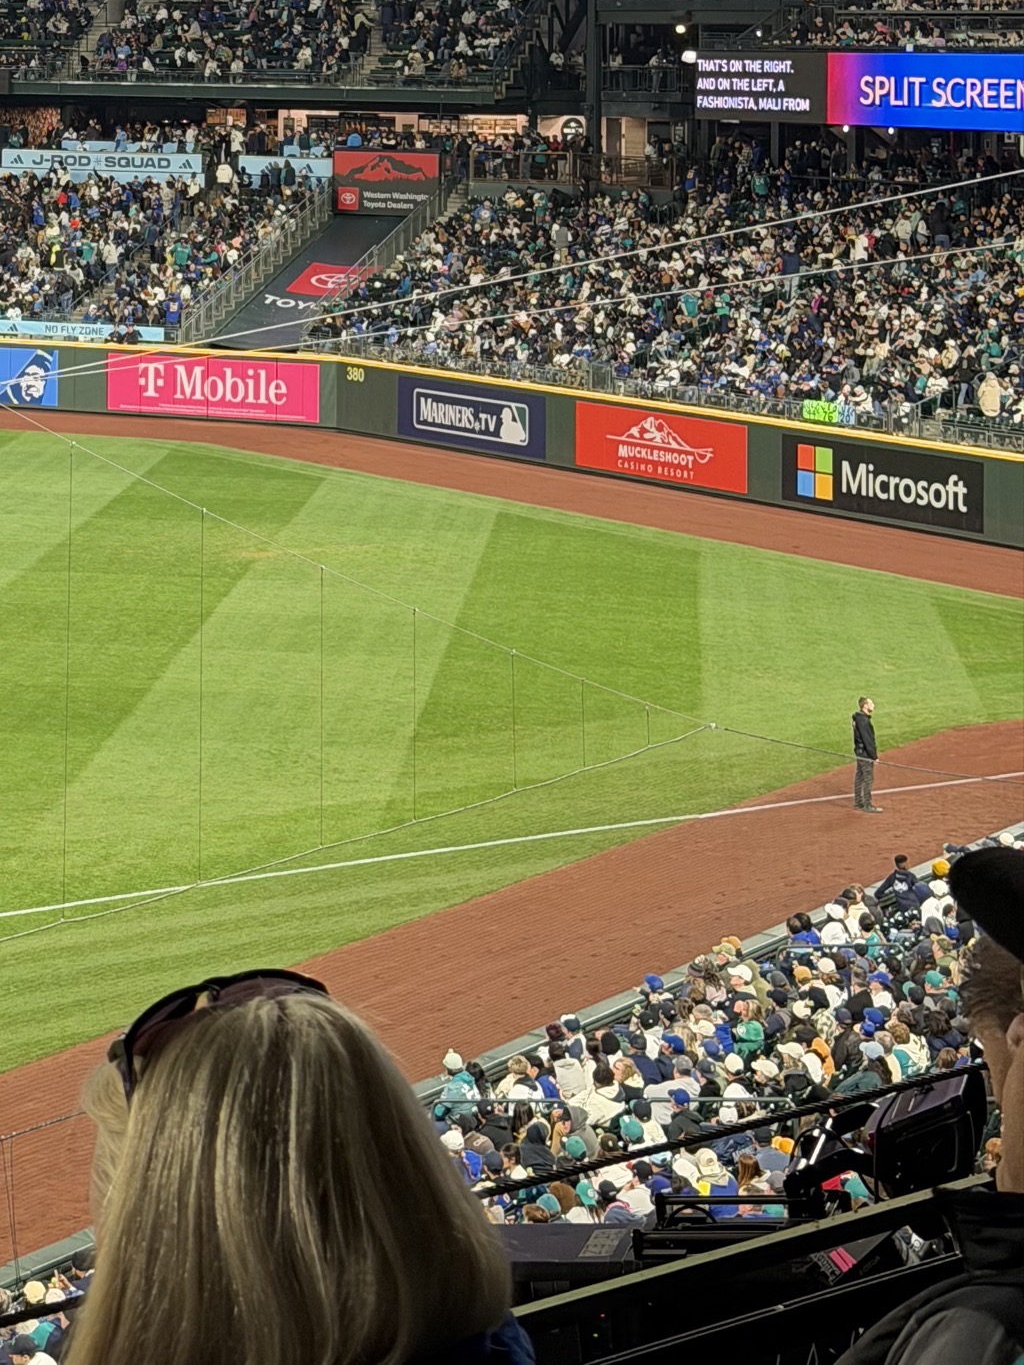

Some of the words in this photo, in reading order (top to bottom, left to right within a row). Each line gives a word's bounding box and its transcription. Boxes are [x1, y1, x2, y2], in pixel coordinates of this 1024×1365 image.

[697, 59, 728, 72] THAT'S
[729, 60, 742, 72] ON
[744, 60, 762, 73] THE
[763, 60, 794, 74] RIGHT.
[696, 78, 716, 90] AND
[717, 78, 730, 90] ON
[731, 78, 750, 91] THE
[751, 78, 776, 93] LEFT,
[777, 79, 785, 92] A
[859, 75, 926, 106] SPLIT
[696, 96, 757, 111] FASHIONISTA,
[758, 98, 781, 111] MALI
[782, 98, 810, 112] FROM
[31, 154, 91, 167] J-ROD
[104, 156, 171, 169] SQUAD
[363, 191, 391, 199] Western
[391, 192, 433, 201] Washingto
[363, 200, 386, 209] Toyota
[387, 201, 414, 209] Dealers
[45, 324, 58, 333] NO
[61, 325, 76, 335] FLY
[79, 326, 104, 336] ZONE
[346, 367, 364, 382] 380
[139, 363, 164, 397] T
[174, 364, 287, 405] Mobile
[618, 444, 694, 468] MUCKLESHOOT
[617, 459, 653, 473] CASINO
[657, 466, 694, 480] RESORT
[841, 459, 968, 513] Microsoft
